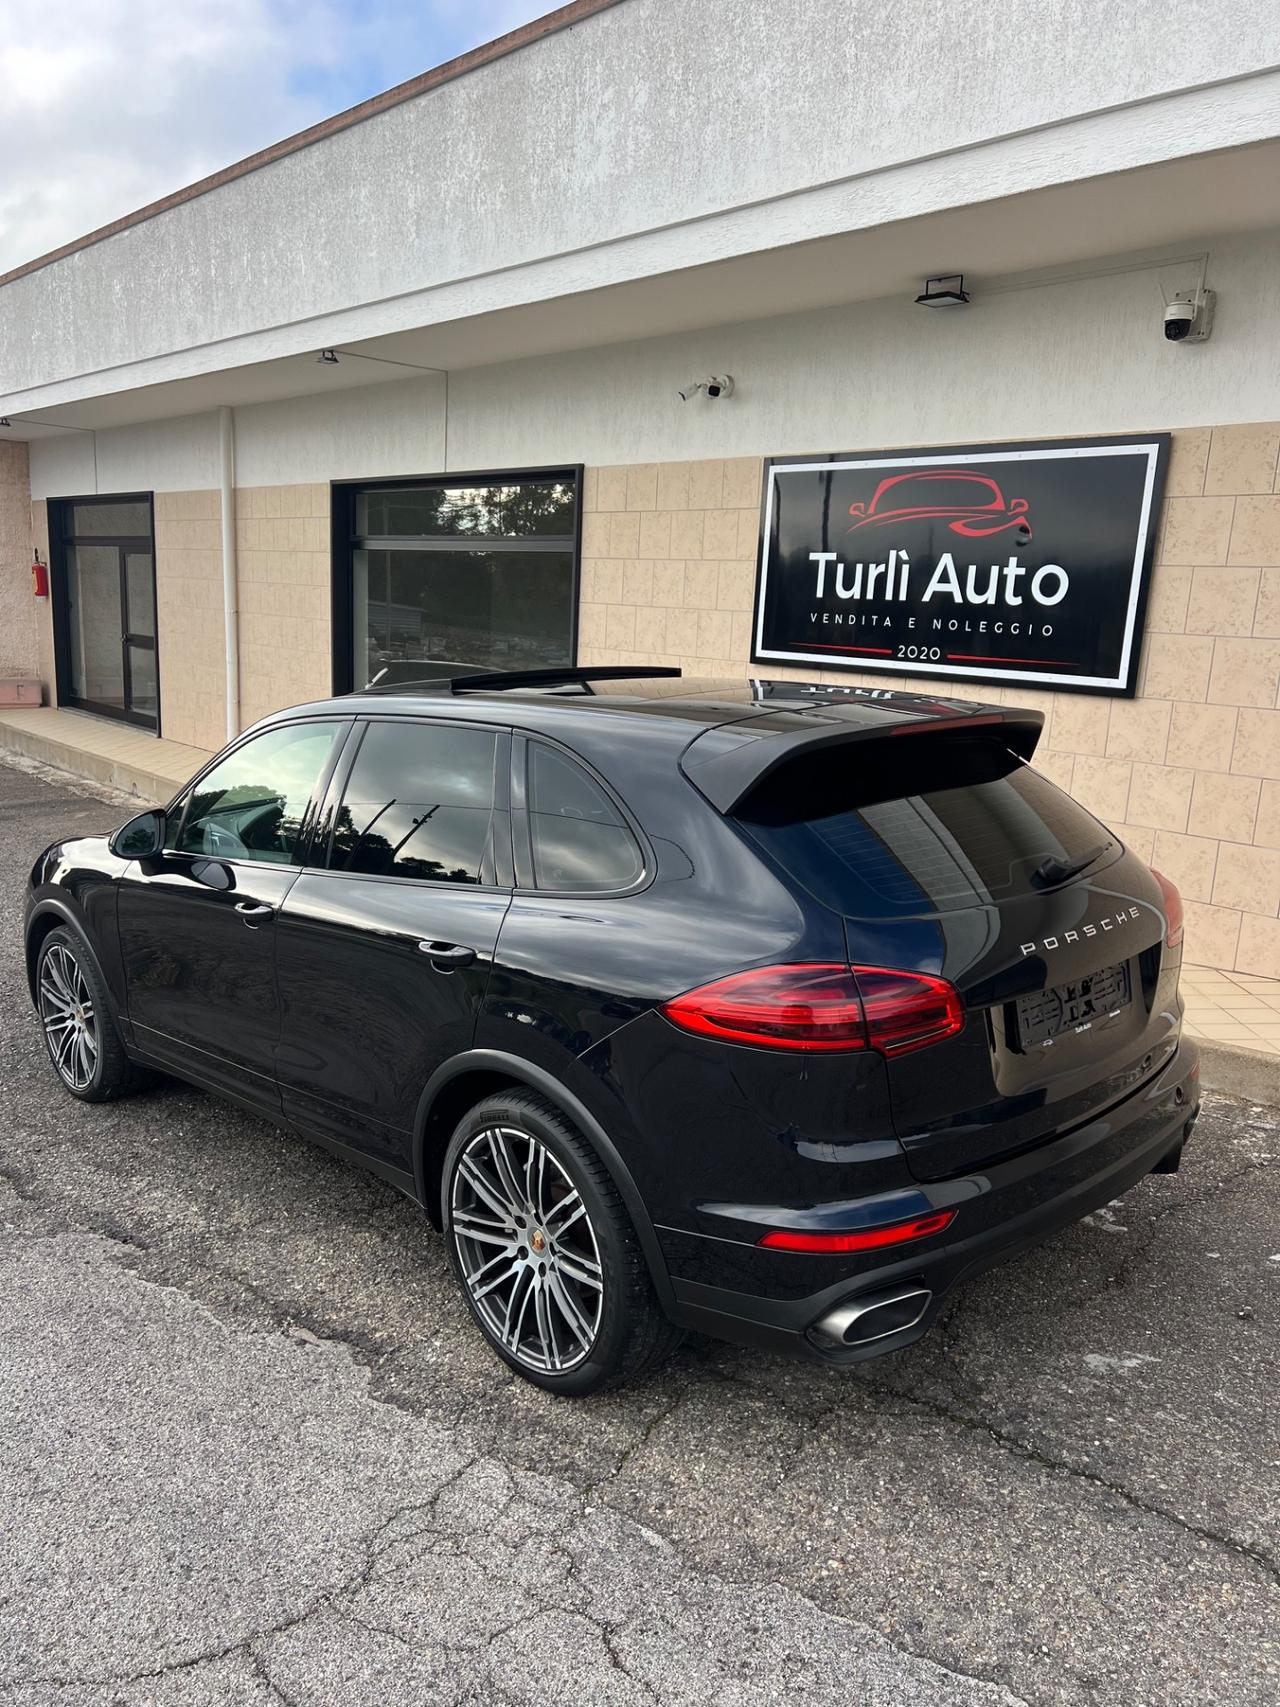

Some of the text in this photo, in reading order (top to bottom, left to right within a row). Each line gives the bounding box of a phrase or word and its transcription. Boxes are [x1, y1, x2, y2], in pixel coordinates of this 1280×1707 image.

[808, 549, 1070, 607] Turlì Auto
[810, 612, 1053, 637] VENDITA E NOLEGGIO
[897, 644, 941, 660] 2020
[1020, 906, 1140, 956] PORSCHE
